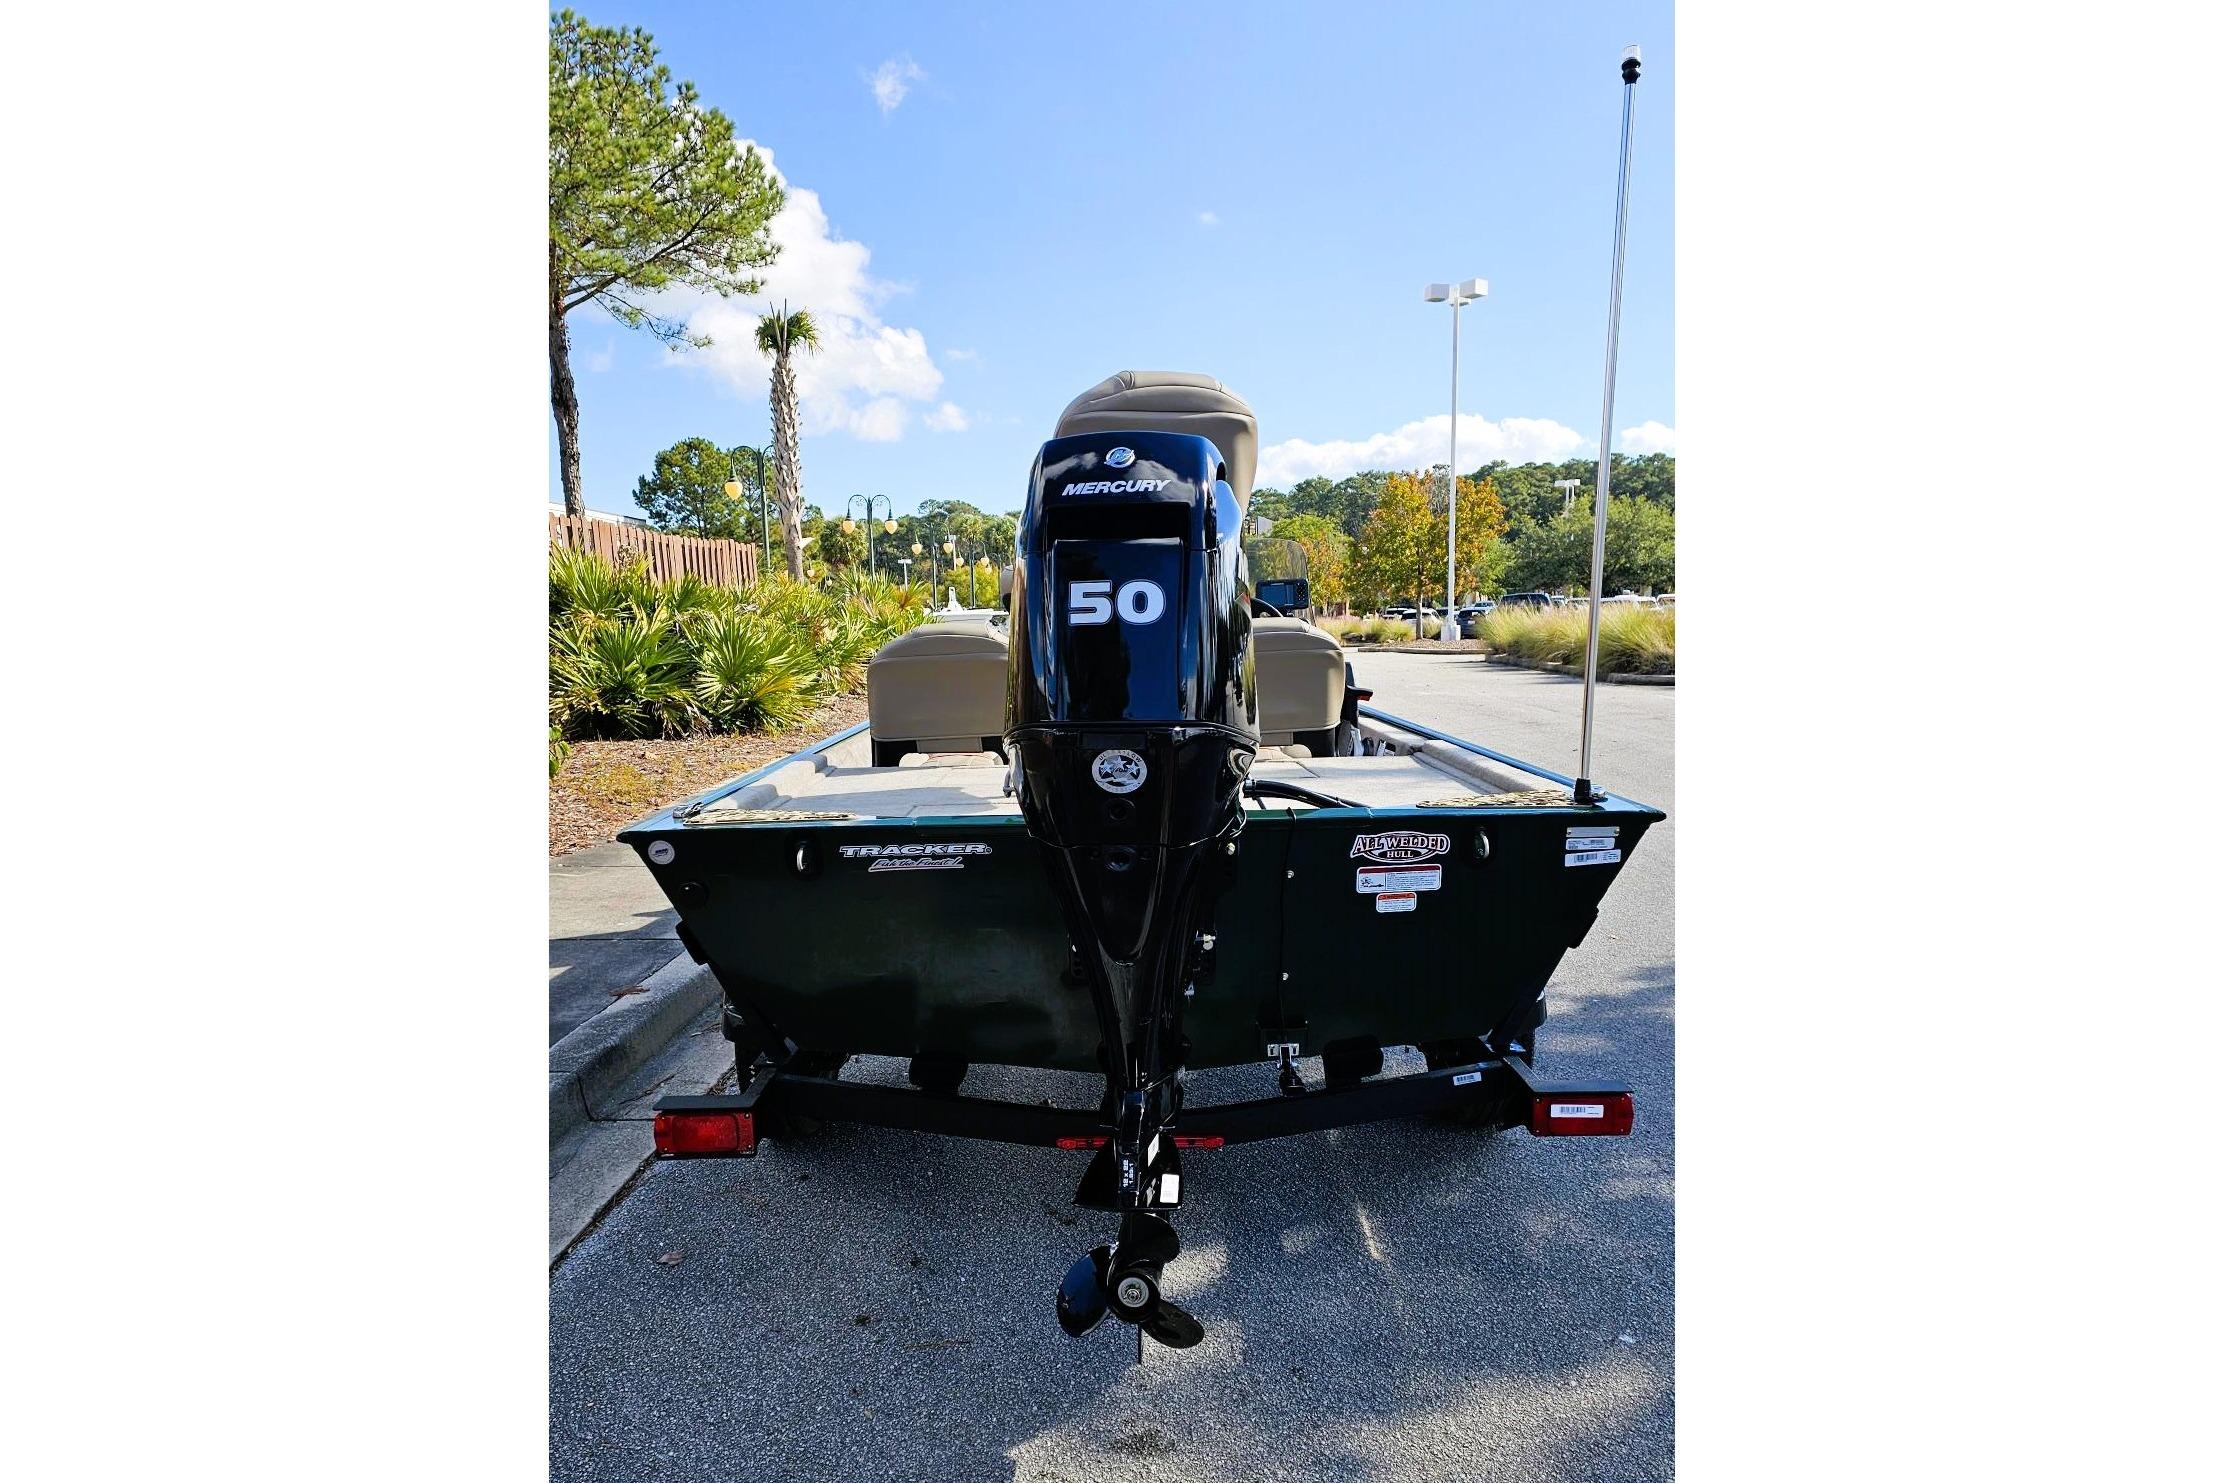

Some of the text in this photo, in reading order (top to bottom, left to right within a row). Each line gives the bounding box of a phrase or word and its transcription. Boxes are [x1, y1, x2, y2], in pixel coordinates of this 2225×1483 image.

[1061, 480, 1172, 496] MERCURY
[1068, 579, 1167, 626] 50
[840, 843, 986, 857] TRACKER
[1353, 836, 1448, 854] ALL WELDED
[1386, 850, 1414, 858] HULL
